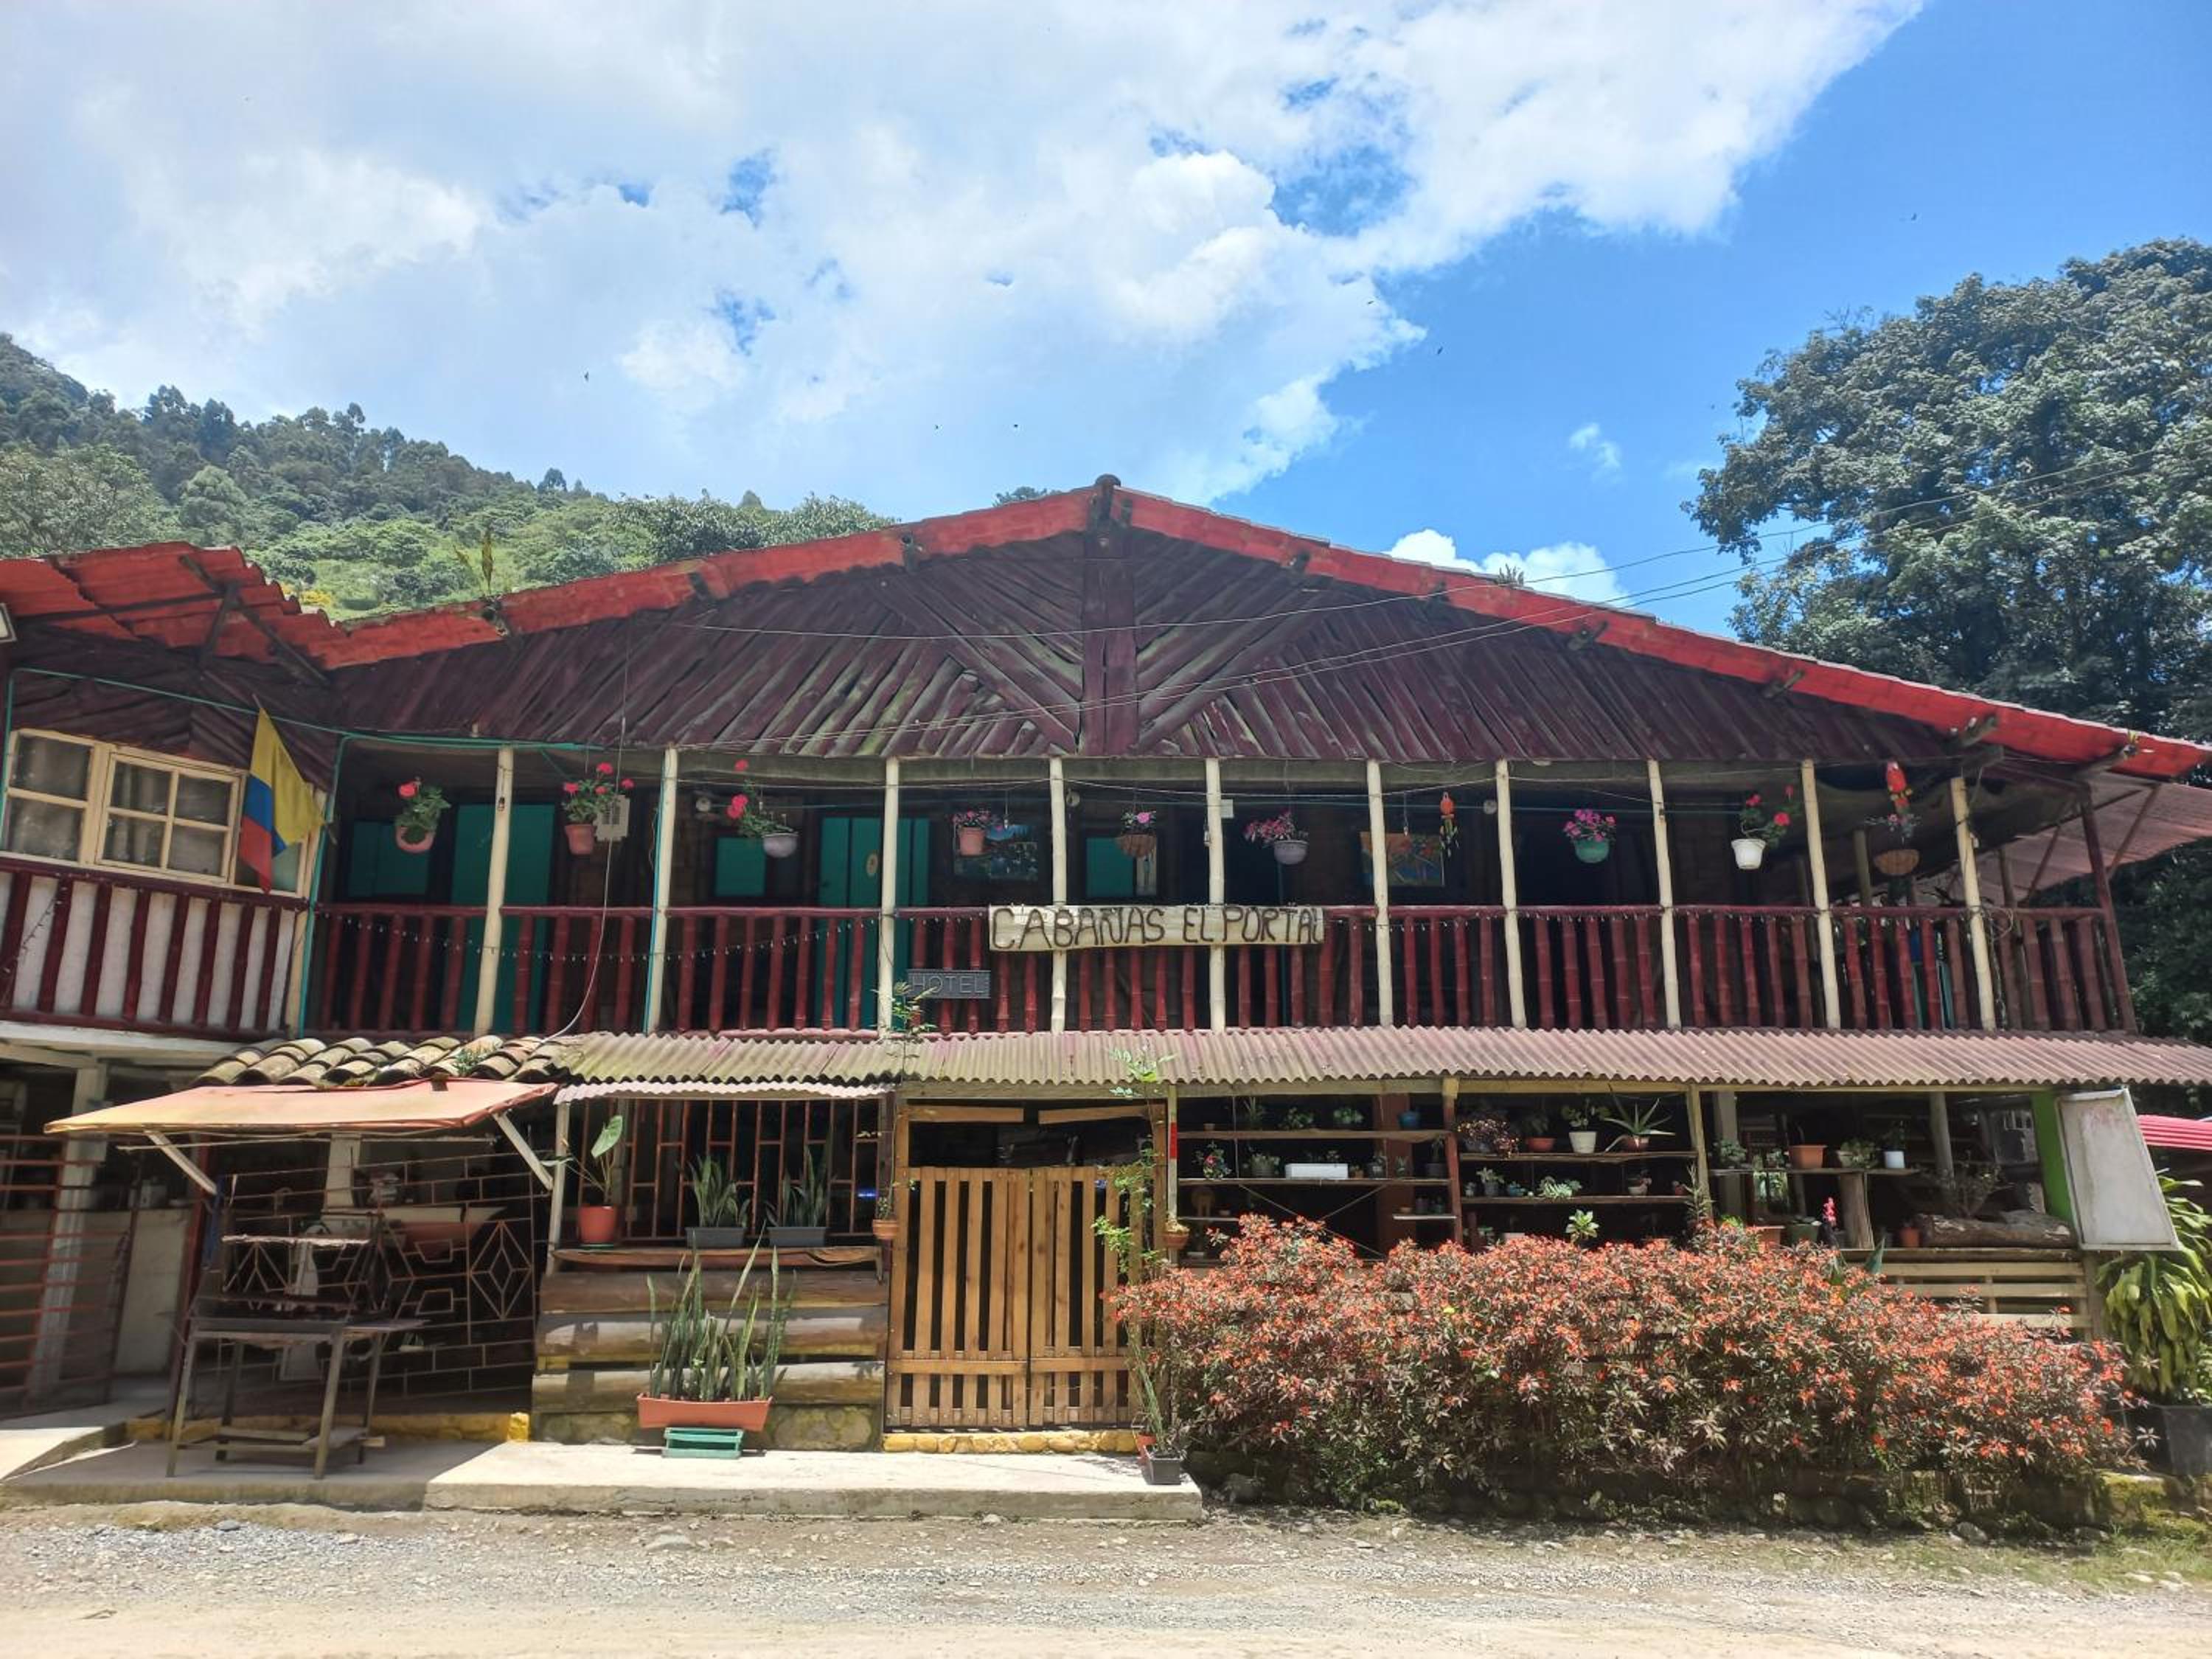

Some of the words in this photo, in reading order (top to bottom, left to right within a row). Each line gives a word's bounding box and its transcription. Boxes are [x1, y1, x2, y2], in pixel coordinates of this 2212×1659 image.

[1182, 907, 1214, 942] EL
[1222, 906, 1324, 943] PORTAL
[912, 975, 985, 994] HOTEL
